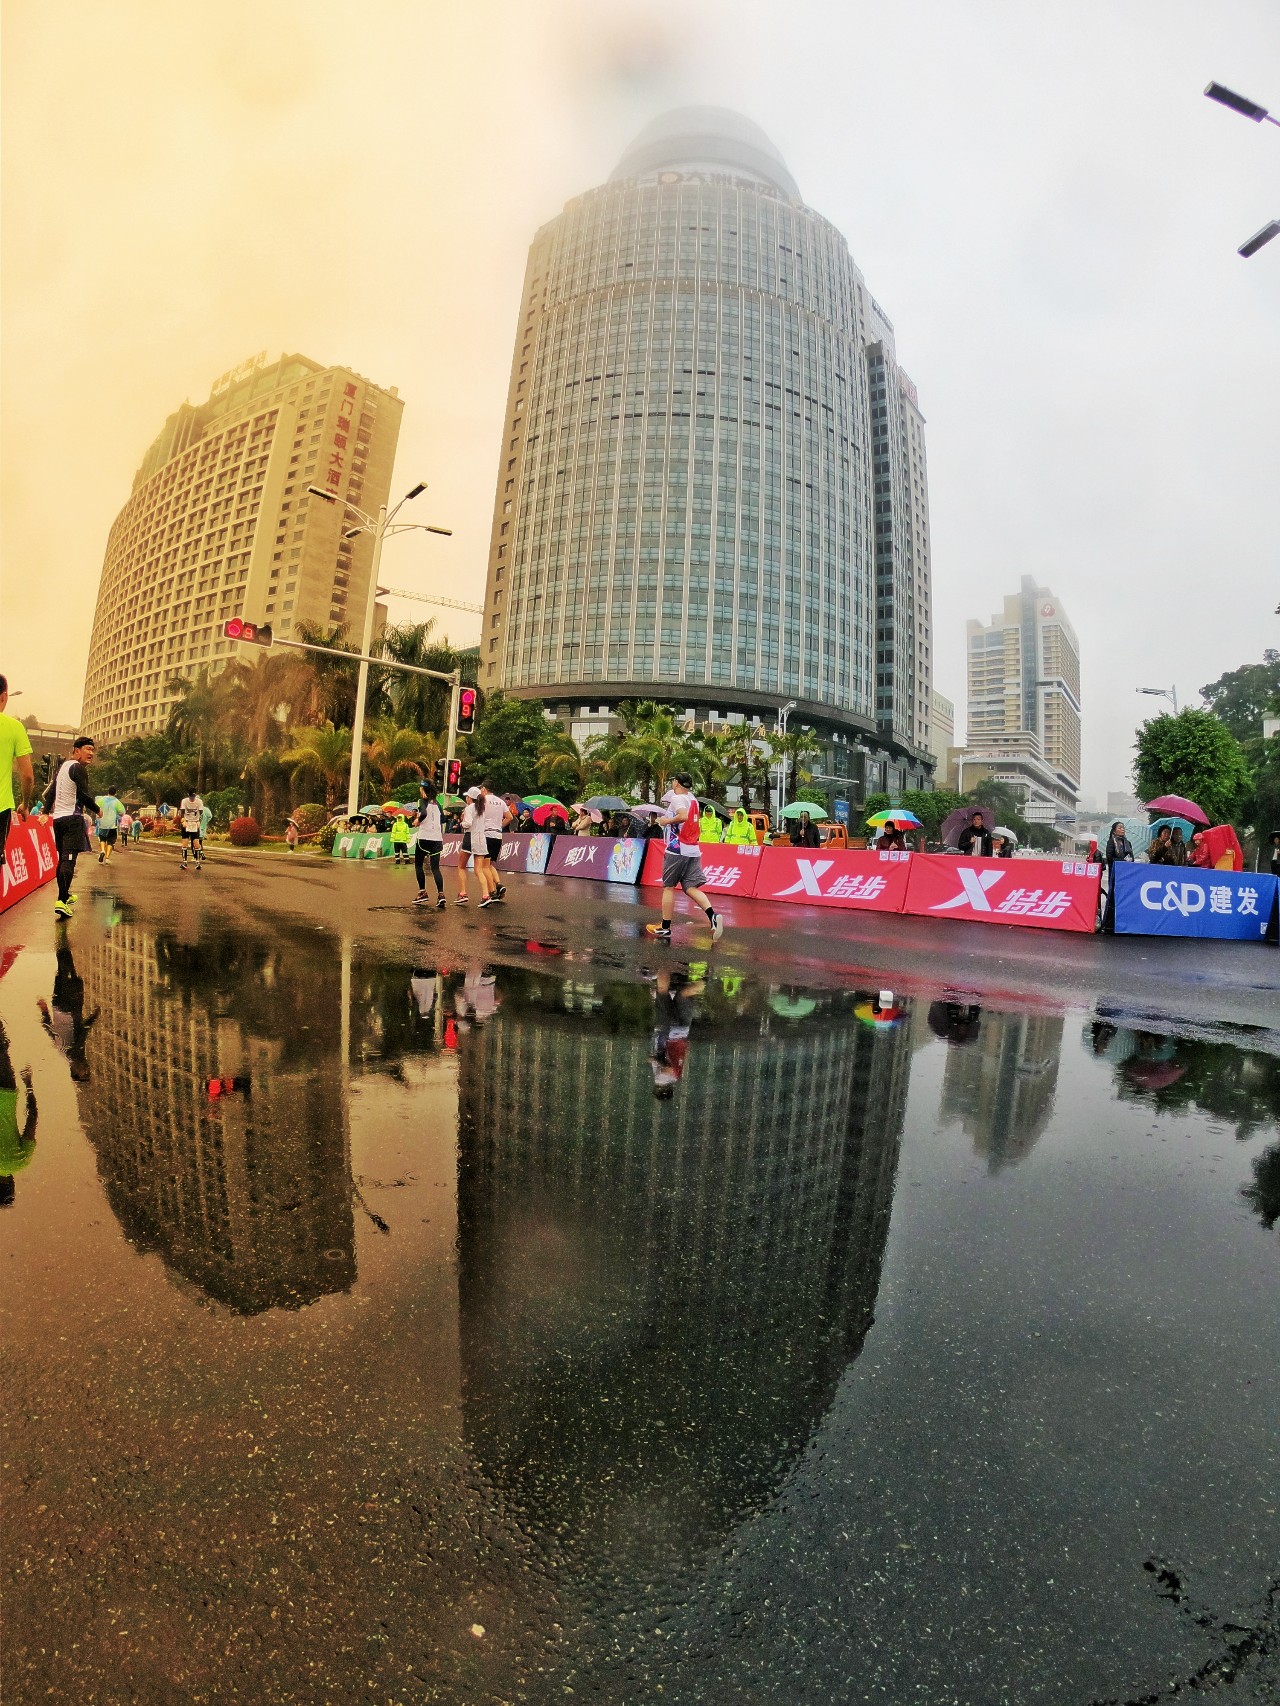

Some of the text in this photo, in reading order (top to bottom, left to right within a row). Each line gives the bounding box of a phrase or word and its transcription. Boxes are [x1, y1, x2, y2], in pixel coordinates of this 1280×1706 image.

[703, 865, 742, 888] 特步
[823, 875, 887, 899] 特步
[993, 888, 1072, 918] 特步
[1140, 880, 1259, 917] C&D 建发
